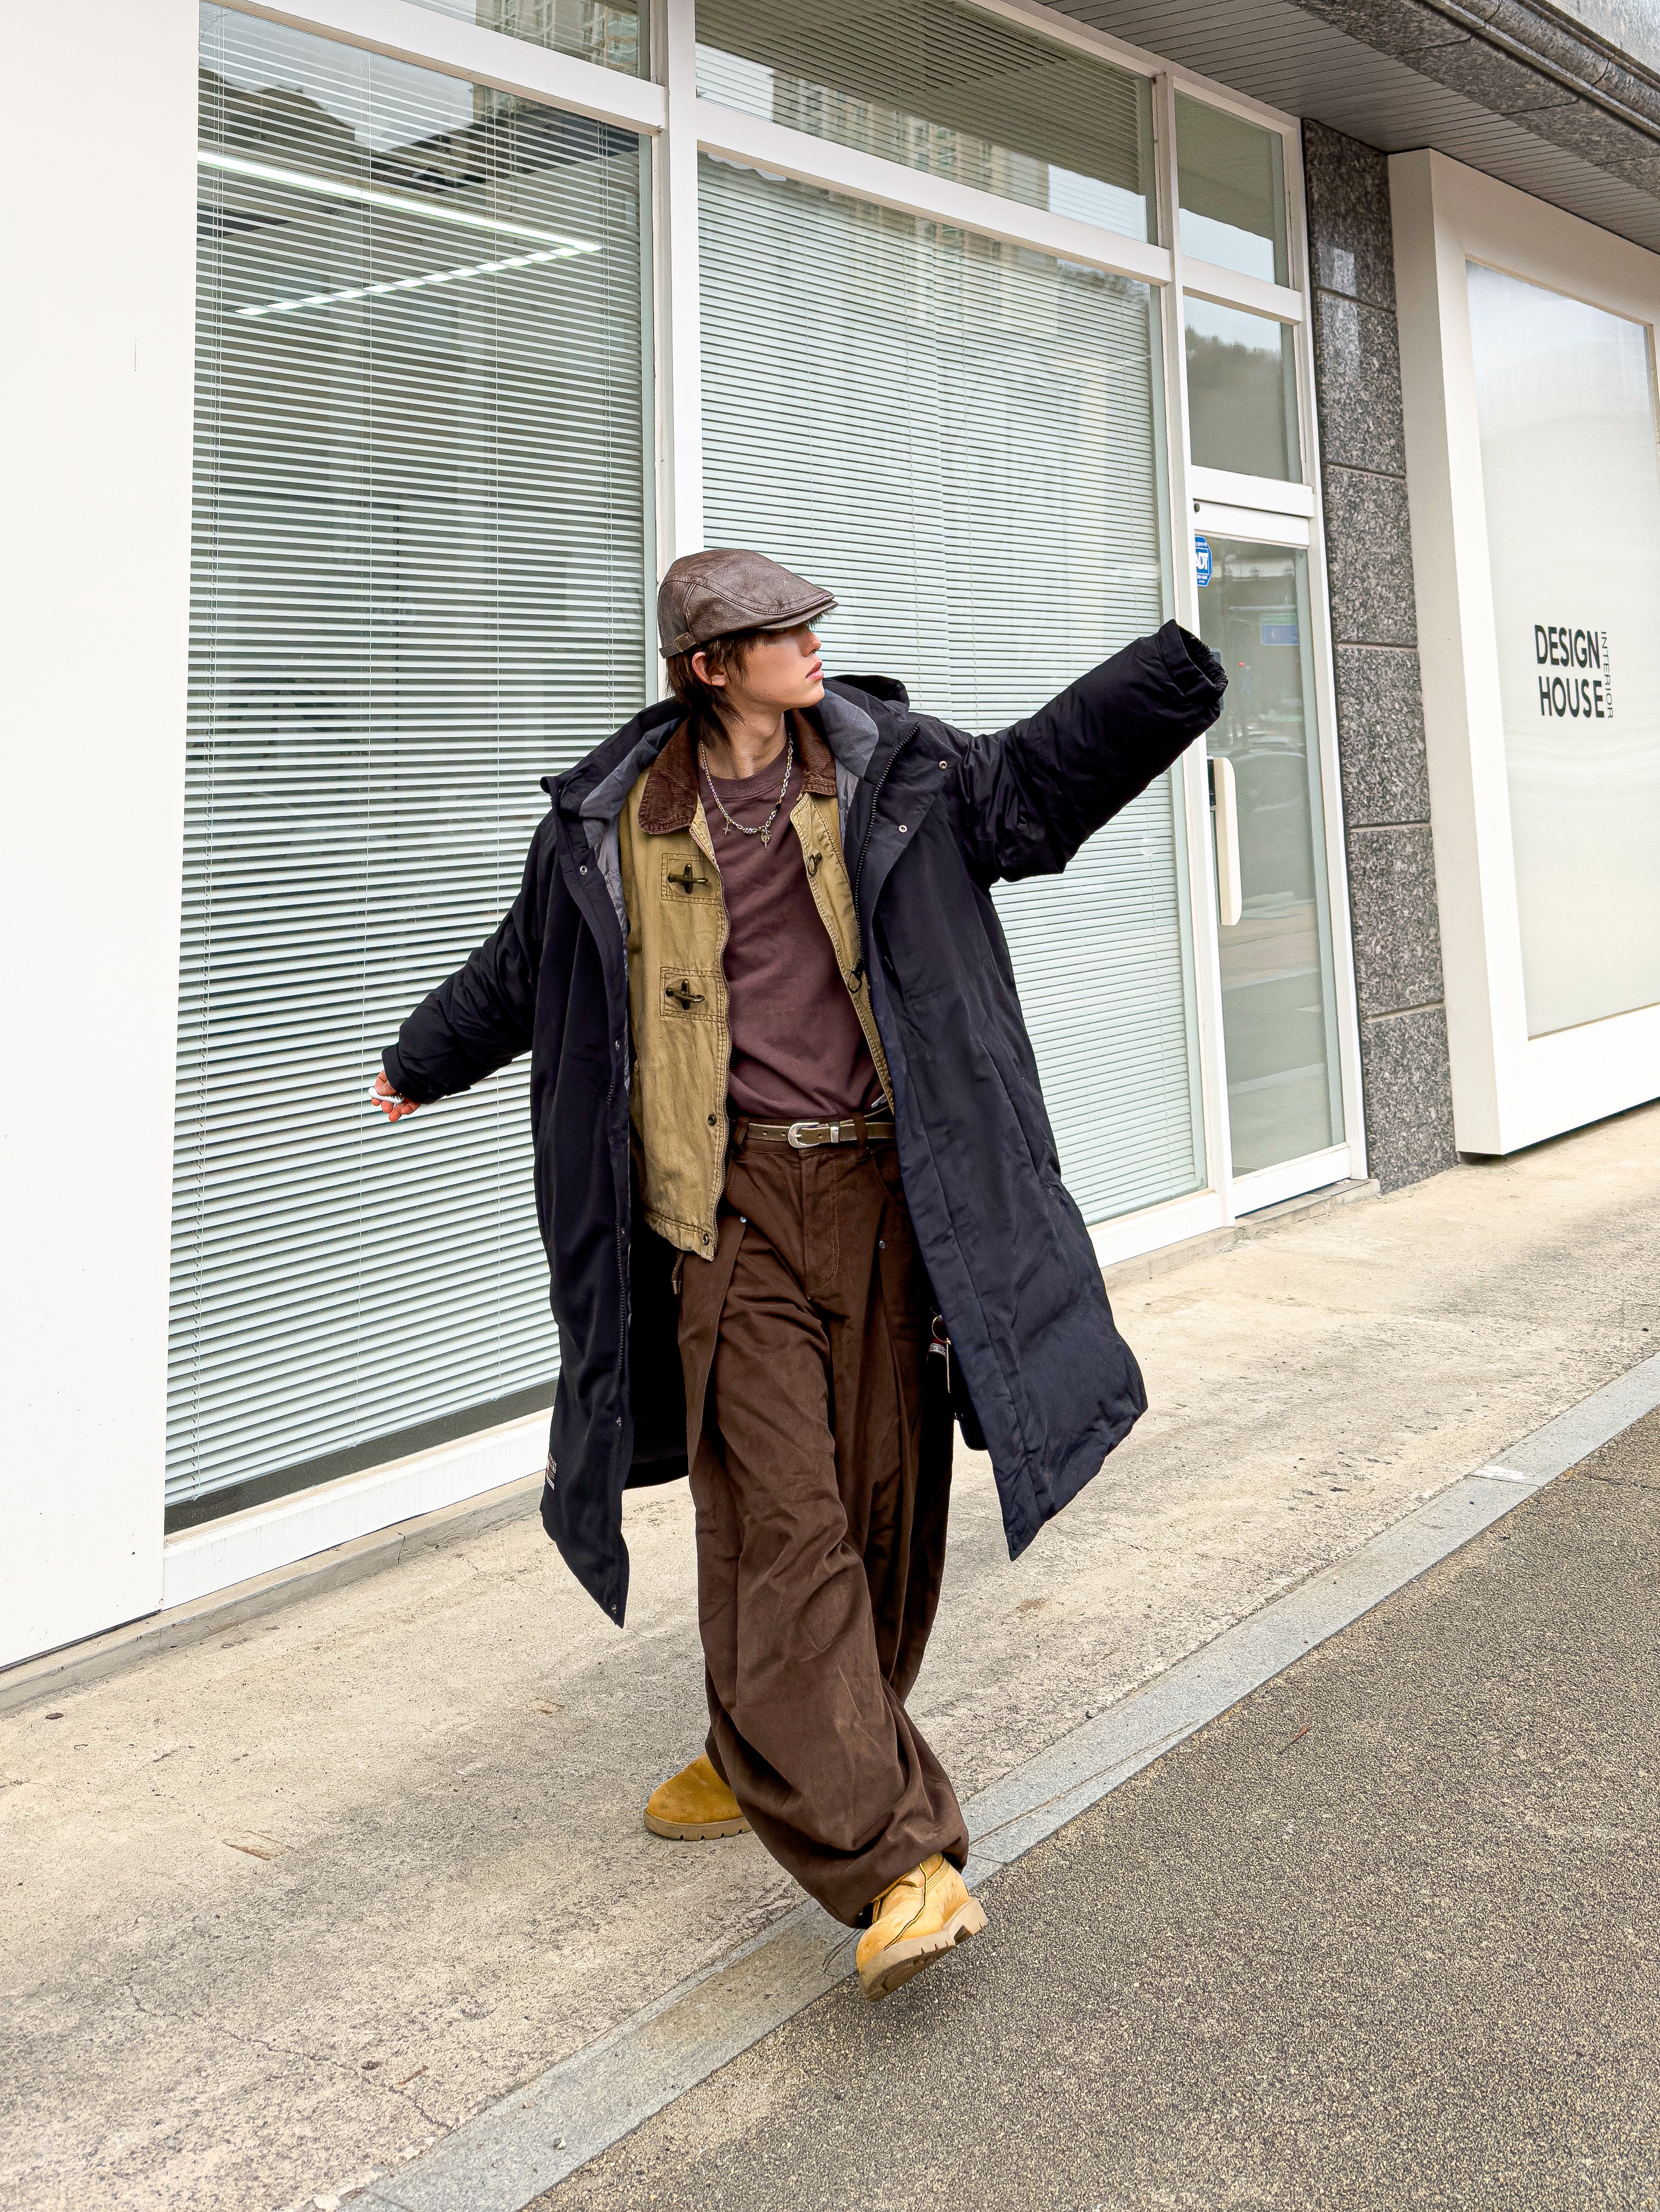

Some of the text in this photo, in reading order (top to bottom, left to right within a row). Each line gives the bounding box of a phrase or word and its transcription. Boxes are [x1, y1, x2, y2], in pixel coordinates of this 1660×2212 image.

[1535, 624, 1601, 669] DESIGN
[1538, 676, 1605, 719] HOUSE
[1601, 631, 1613, 719] INTERIOR
